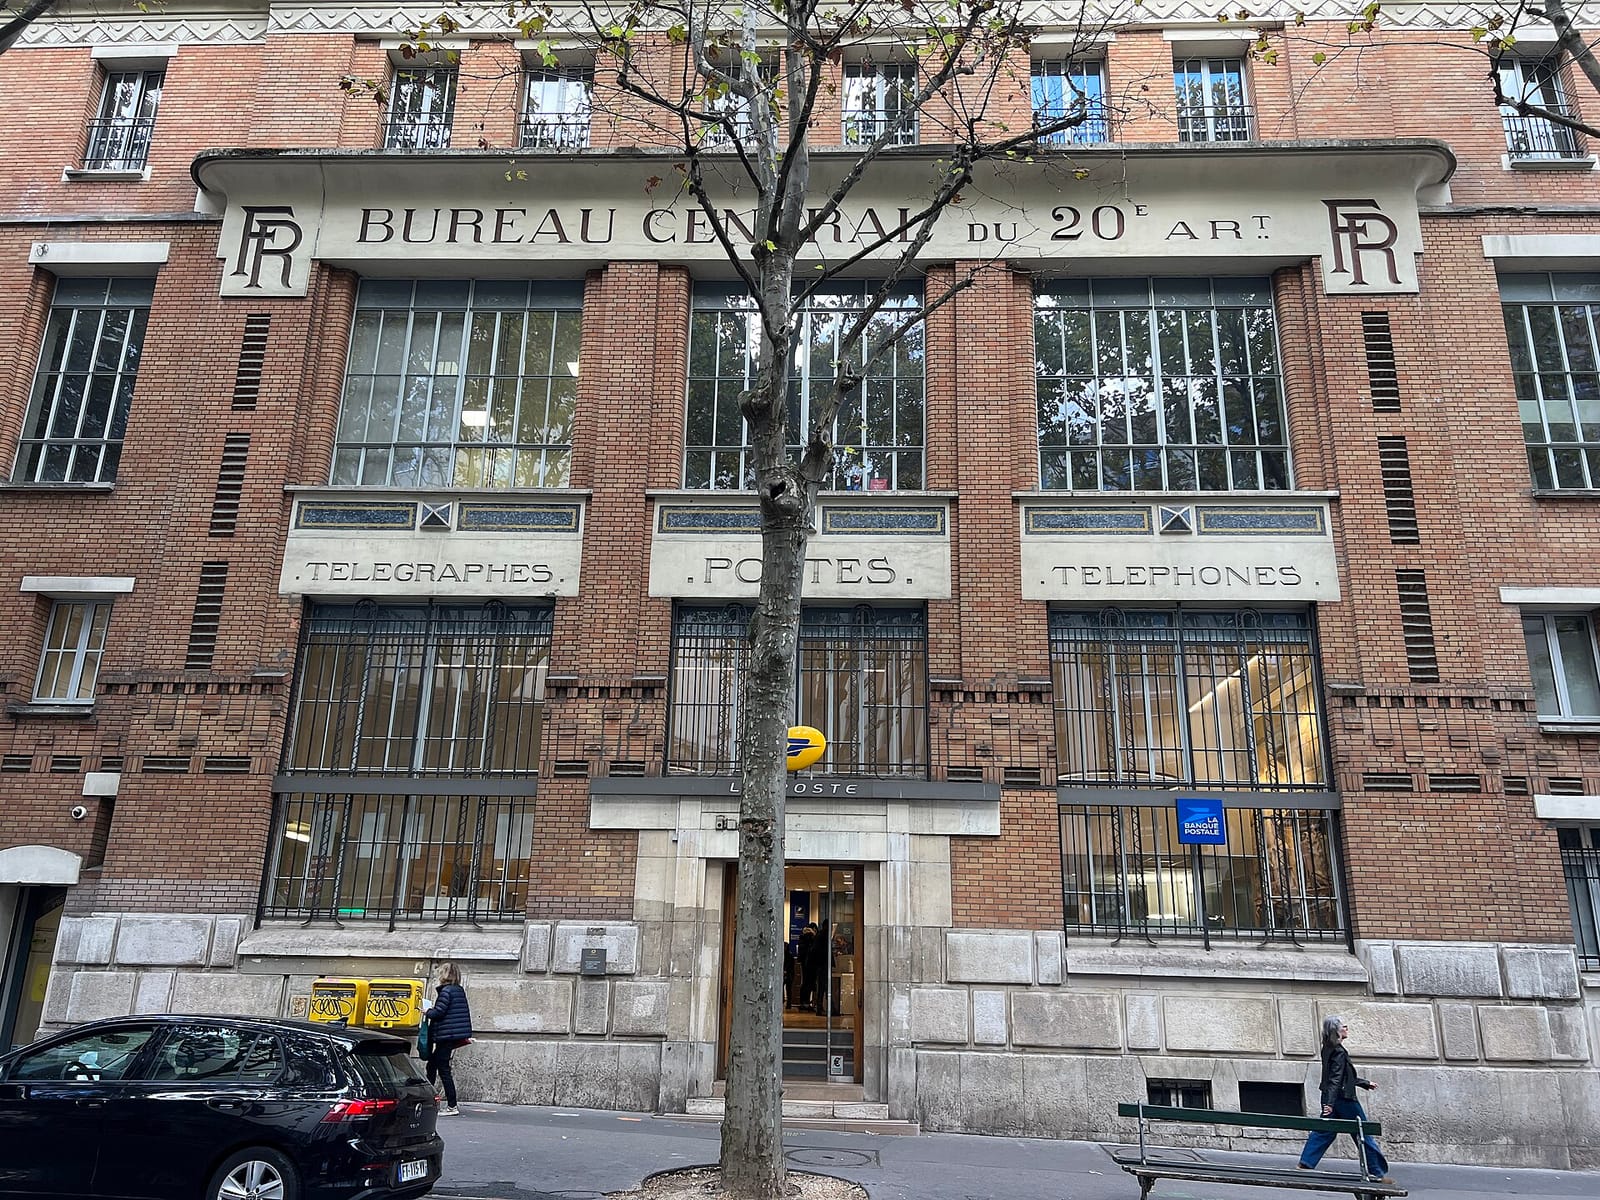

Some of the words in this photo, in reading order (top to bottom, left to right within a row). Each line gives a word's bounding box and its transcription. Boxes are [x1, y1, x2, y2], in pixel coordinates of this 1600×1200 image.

[355, 207, 619, 245] BUREAU
[642, 207, 935, 245] CENRAL
[967, 221, 1020, 243] DU
[305, 561, 554, 584] TELEGRAPHES
[703, 555, 897, 584] POTES
[1051, 564, 1303, 587] TELEPHONES
[785, 782, 859, 795] OSTE
